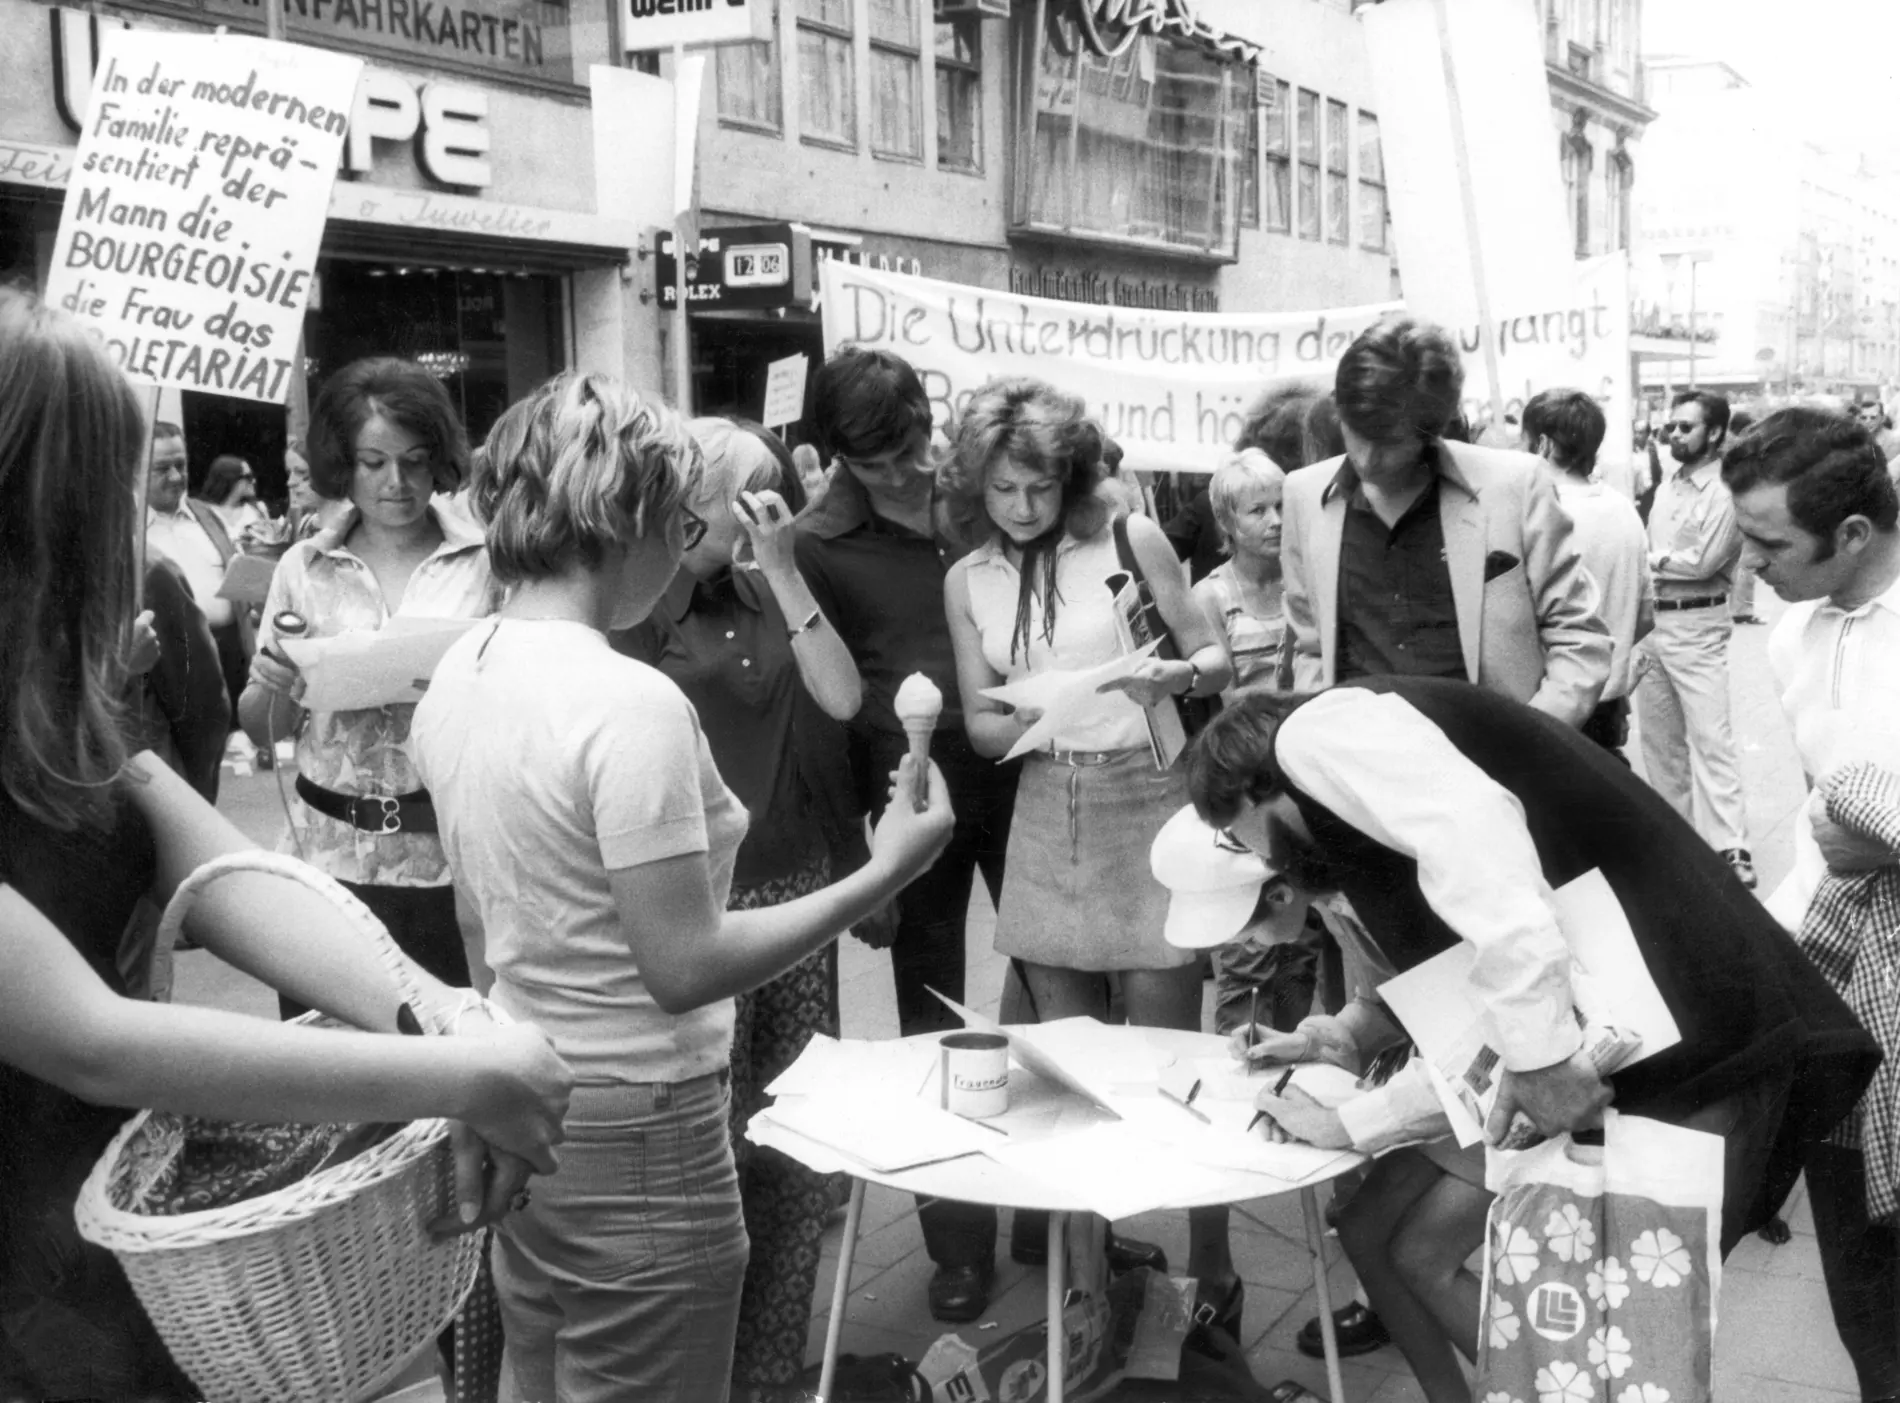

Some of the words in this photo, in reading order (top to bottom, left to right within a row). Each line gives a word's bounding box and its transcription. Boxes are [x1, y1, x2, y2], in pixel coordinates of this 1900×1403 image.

[93, 101, 190, 148] Familie
[102, 57, 128, 93] In
[136, 60, 186, 98] der
[191, 69, 348, 137] modernen
[82, 147, 200, 190] sentiert
[222, 168, 288, 209] der
[76, 186, 167, 231] Mann
[178, 194, 233, 243] die
[735, 255, 755, 277] 12
[61, 279, 107, 318] die
[121, 287, 193, 331] Frau
[204, 300, 274, 348] das
[842, 283, 930, 345] Die
[948, 297, 1281, 374] Unterdrückung
[1102, 390, 1176, 443] und
[1196, 390, 1246, 445] hö
